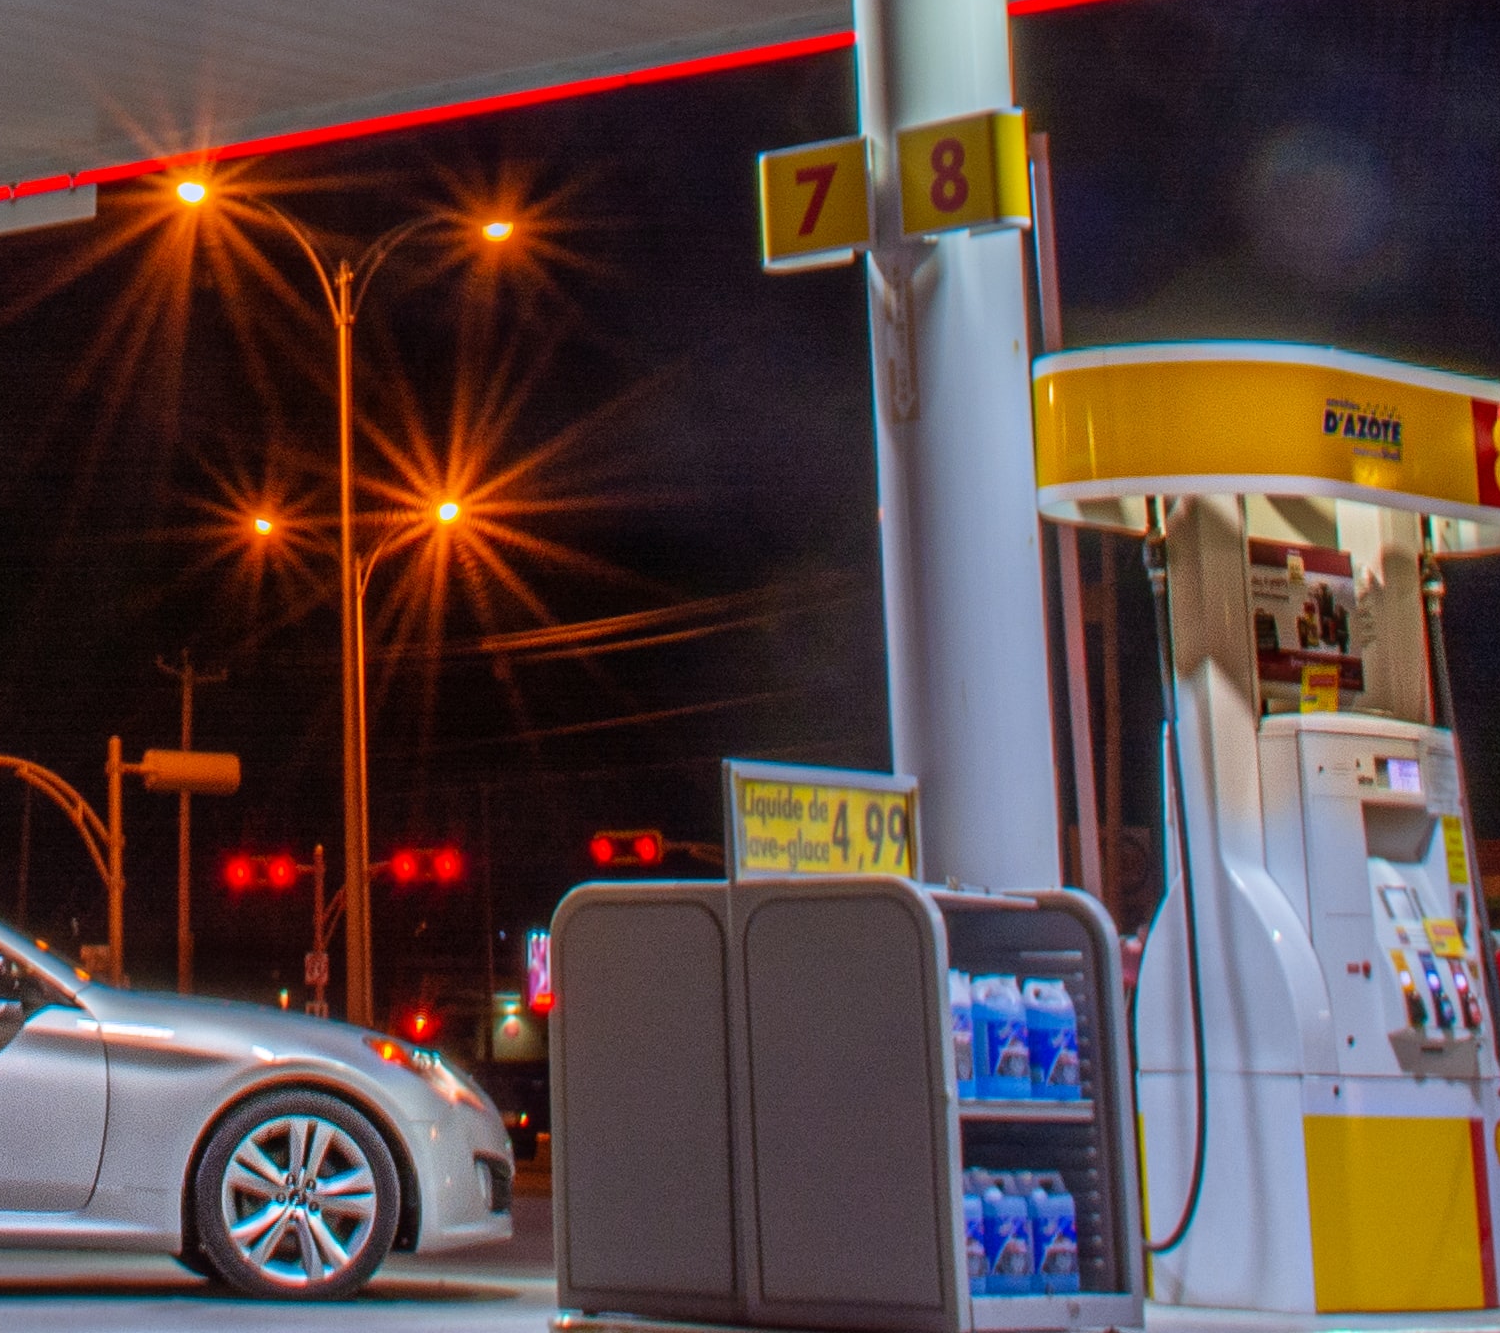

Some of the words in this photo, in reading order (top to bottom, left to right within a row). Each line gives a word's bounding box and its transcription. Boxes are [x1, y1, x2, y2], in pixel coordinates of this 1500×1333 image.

[795, 162, 838, 237] 7
[930, 137, 969, 213] 8
[1323, 408, 1402, 443] D'AZOTE
[742, 785, 804, 825] Liquide
[808, 787, 829, 822] de
[748, 828, 831, 873] ave-glace
[832, 800, 908, 871] 4,99
